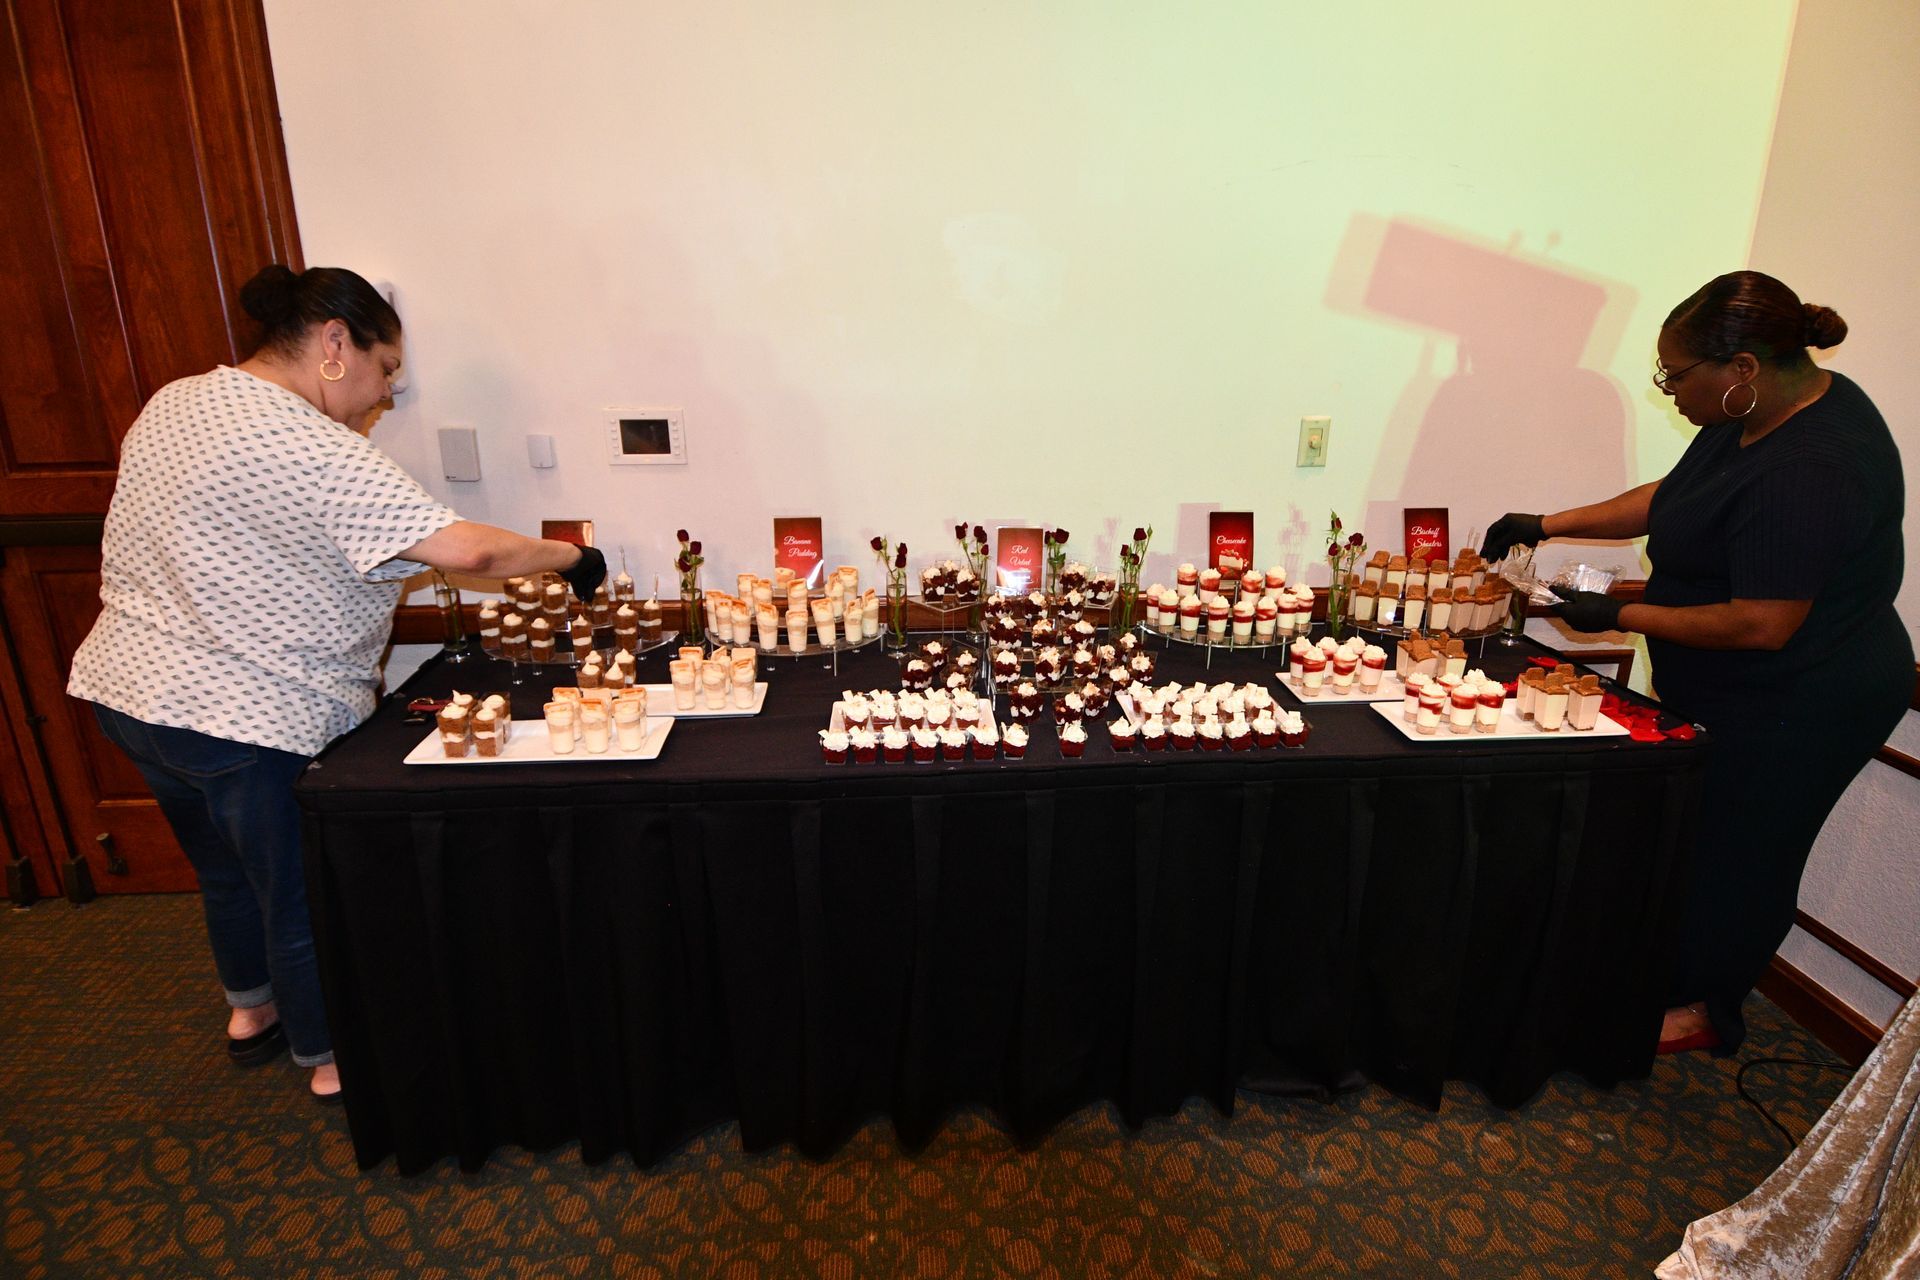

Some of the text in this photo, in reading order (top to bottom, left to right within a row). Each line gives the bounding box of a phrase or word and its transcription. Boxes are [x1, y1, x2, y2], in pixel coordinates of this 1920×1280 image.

[783, 535, 812, 545] Banana
[1216, 535, 1247, 545] Cheesecake
[1413, 537, 1442, 548] Shooters
[788, 547, 818, 559] Pudding
[1010, 544, 1029, 554] Red
